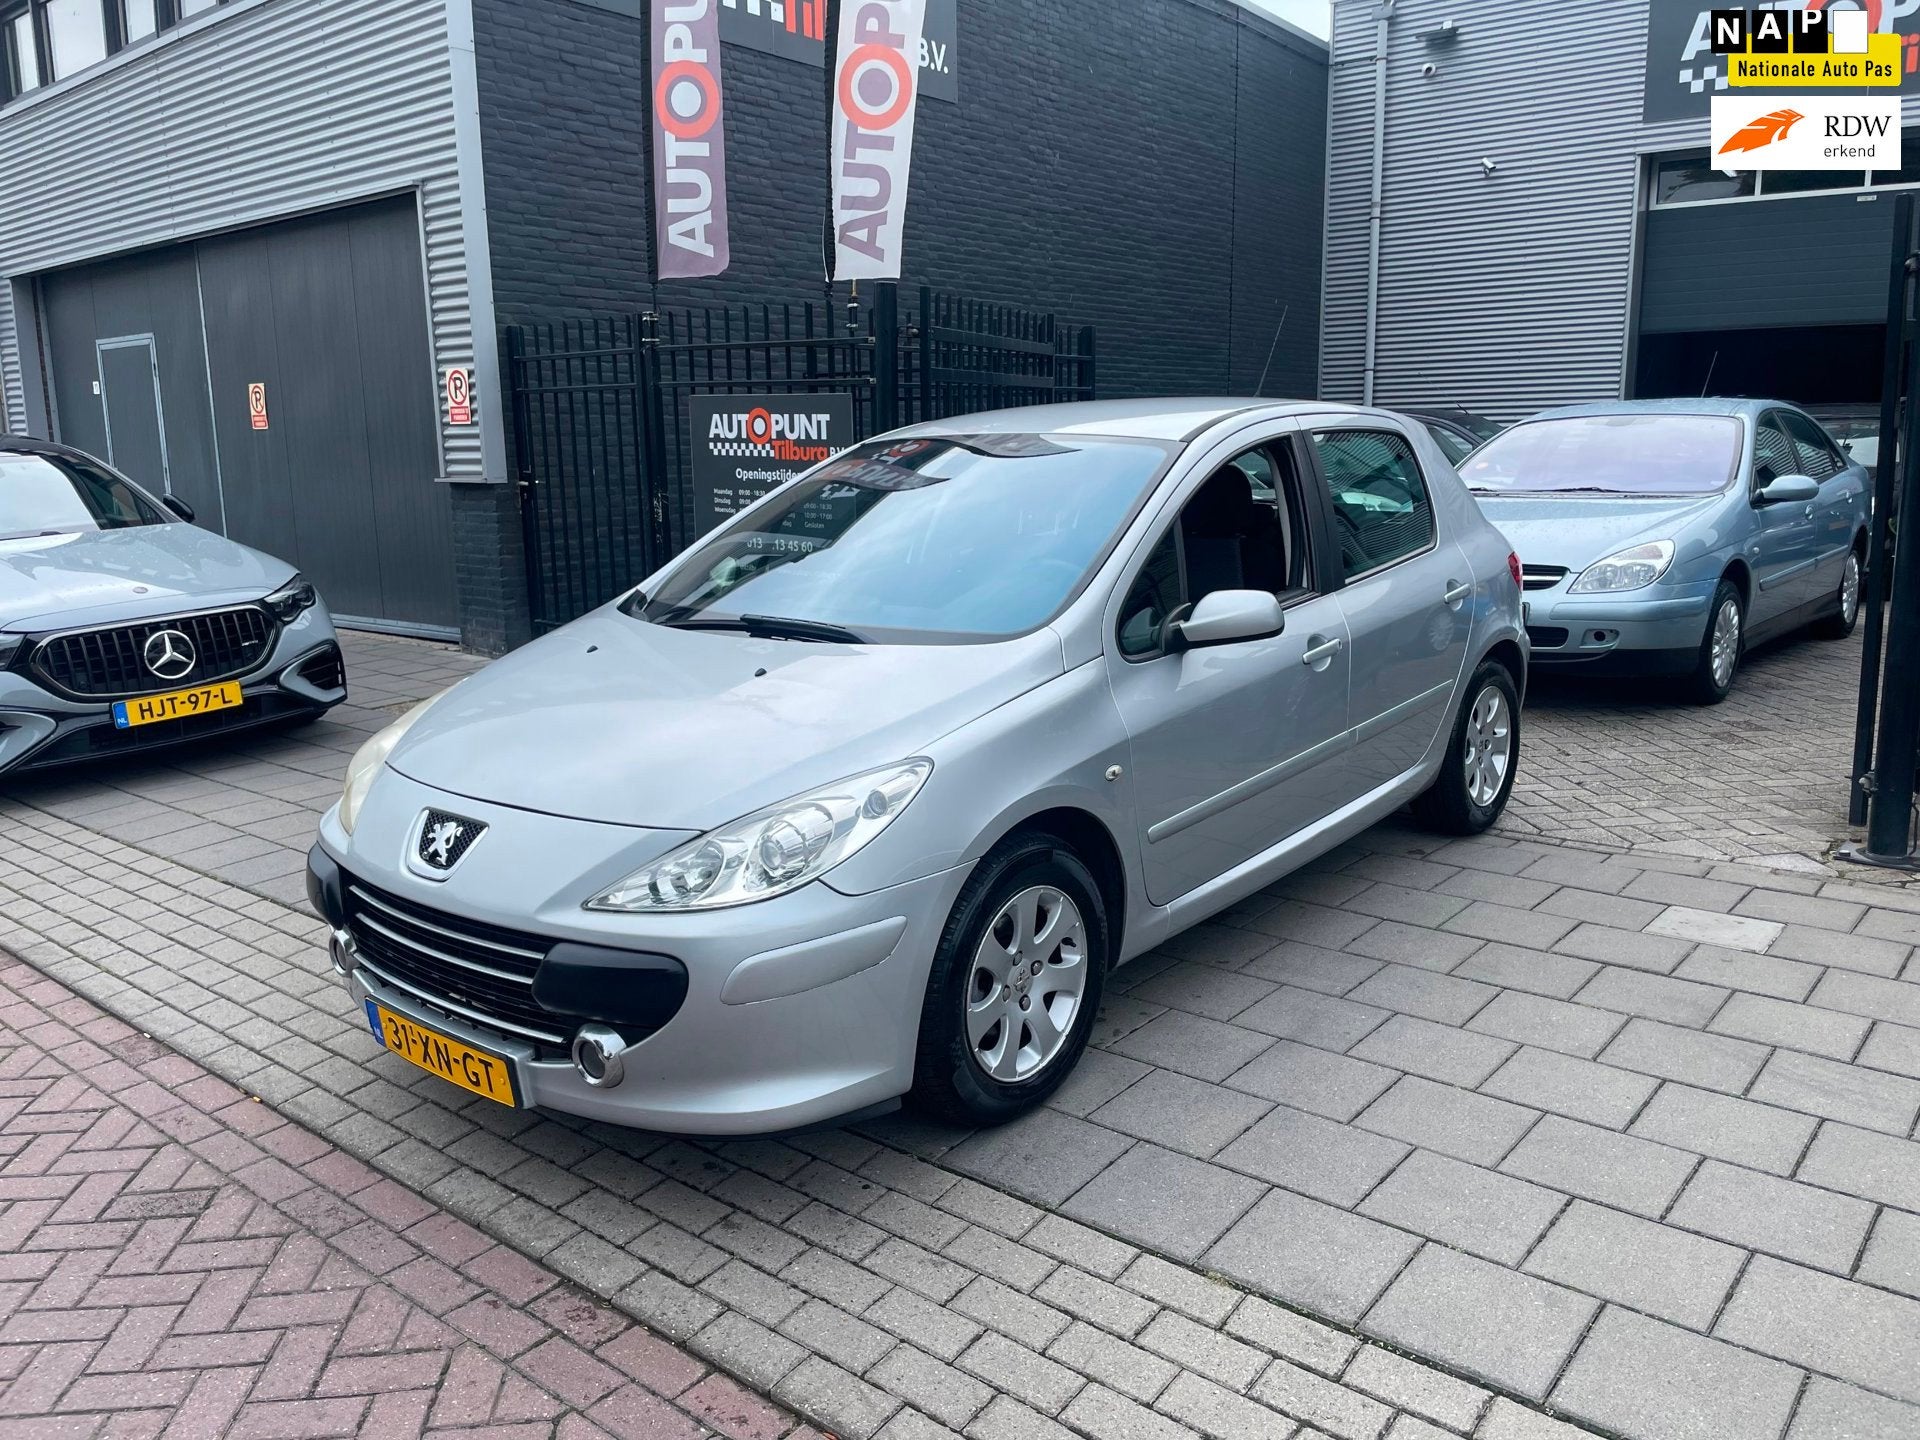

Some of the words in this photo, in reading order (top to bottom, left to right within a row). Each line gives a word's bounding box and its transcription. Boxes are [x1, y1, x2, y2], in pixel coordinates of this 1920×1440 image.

[709, 408, 830, 444] AUTOPUNT
[787, 540, 800, 552] 45
[801, 541, 813, 553] 60
[138, 687, 233, 721] HJT-97-L
[387, 1016, 494, 1094] 31-XN-GT
